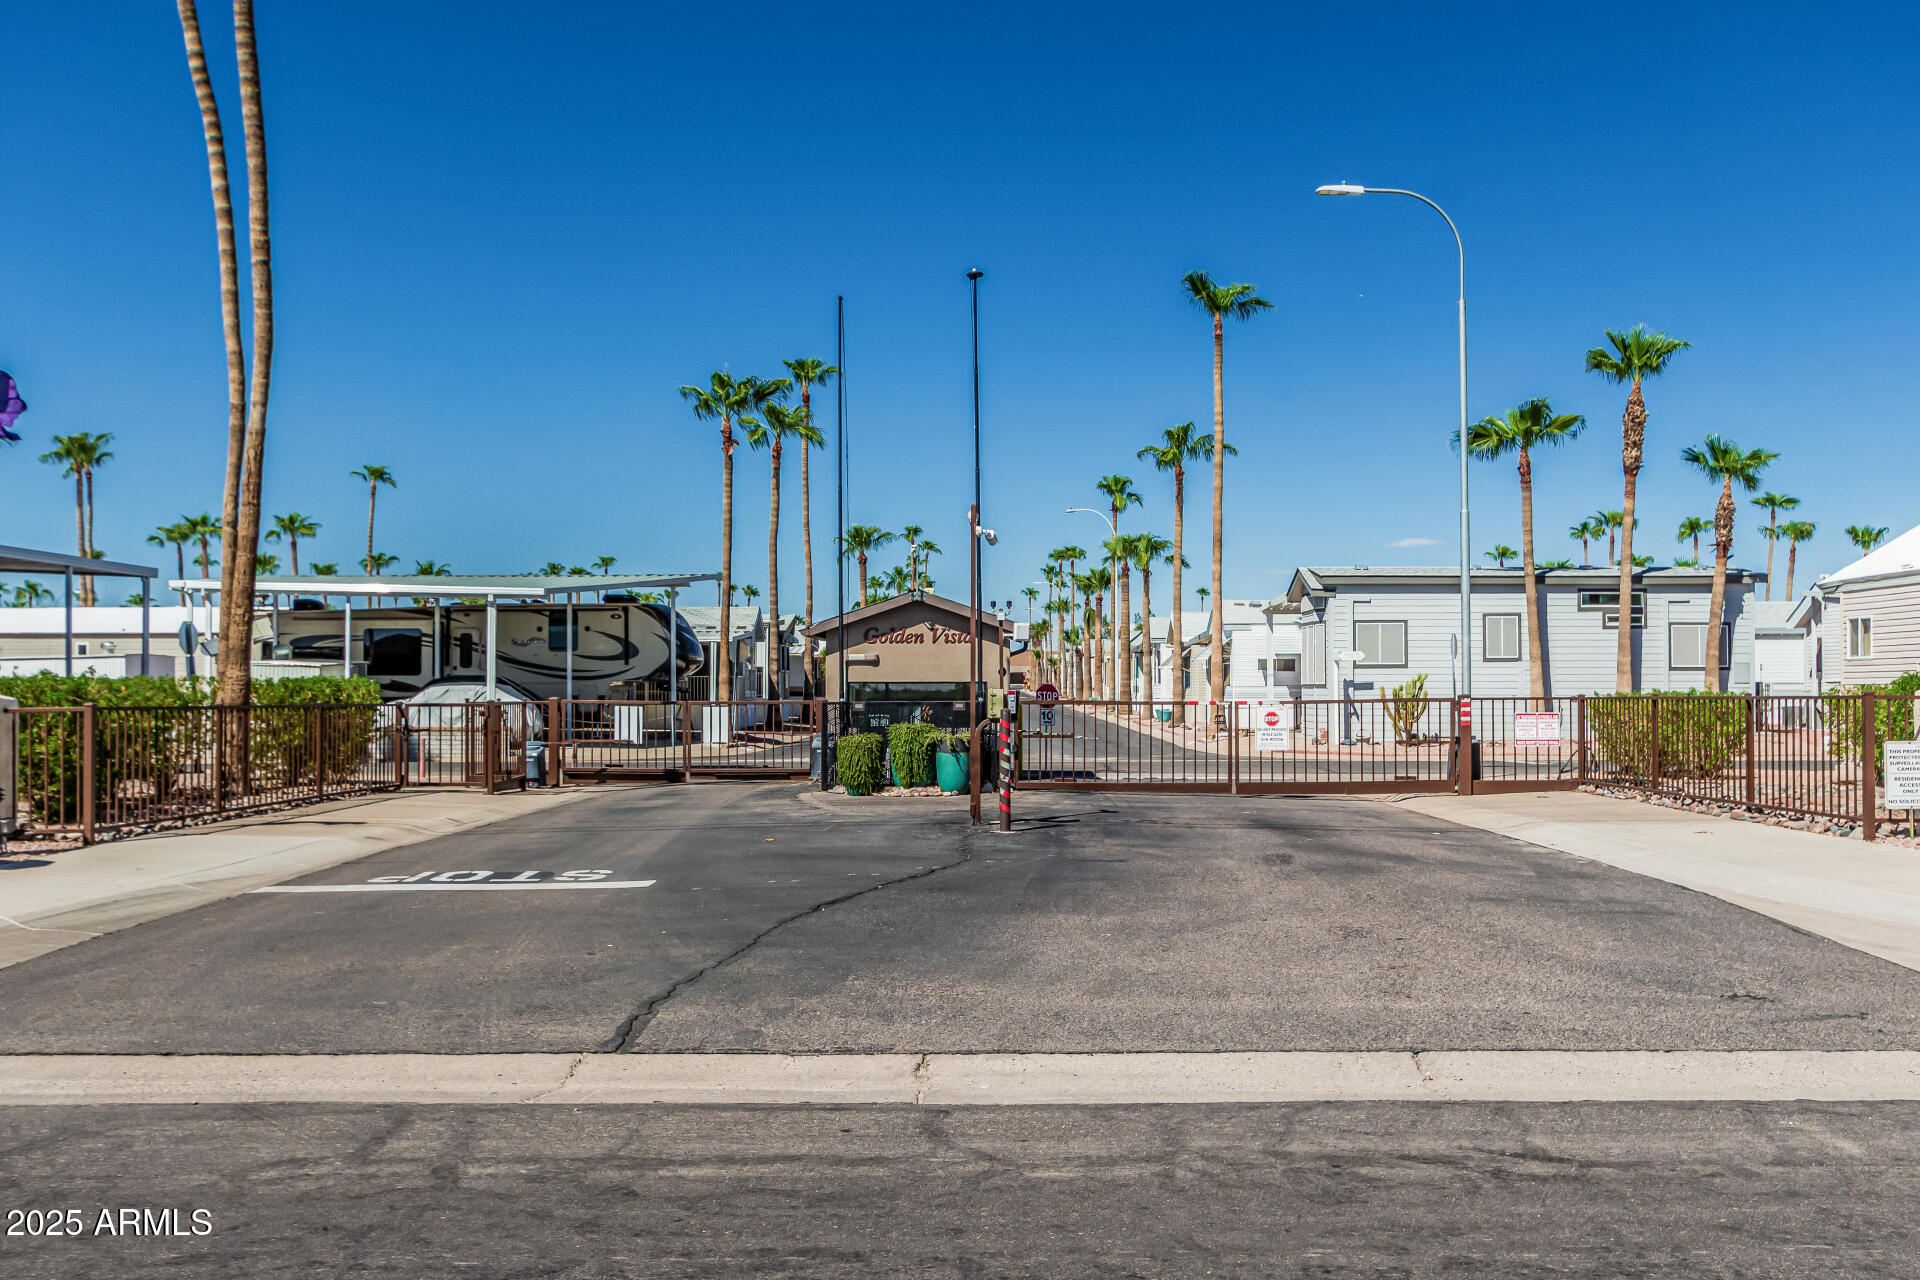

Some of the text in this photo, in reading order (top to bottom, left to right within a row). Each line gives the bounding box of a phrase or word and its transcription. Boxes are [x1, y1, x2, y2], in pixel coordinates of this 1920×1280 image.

[863, 627, 974, 645] Golden Vista
[1037, 691, 1058, 700] STOP
[1041, 711, 1054, 720] 10
[367, 869, 614, 883] STOP
